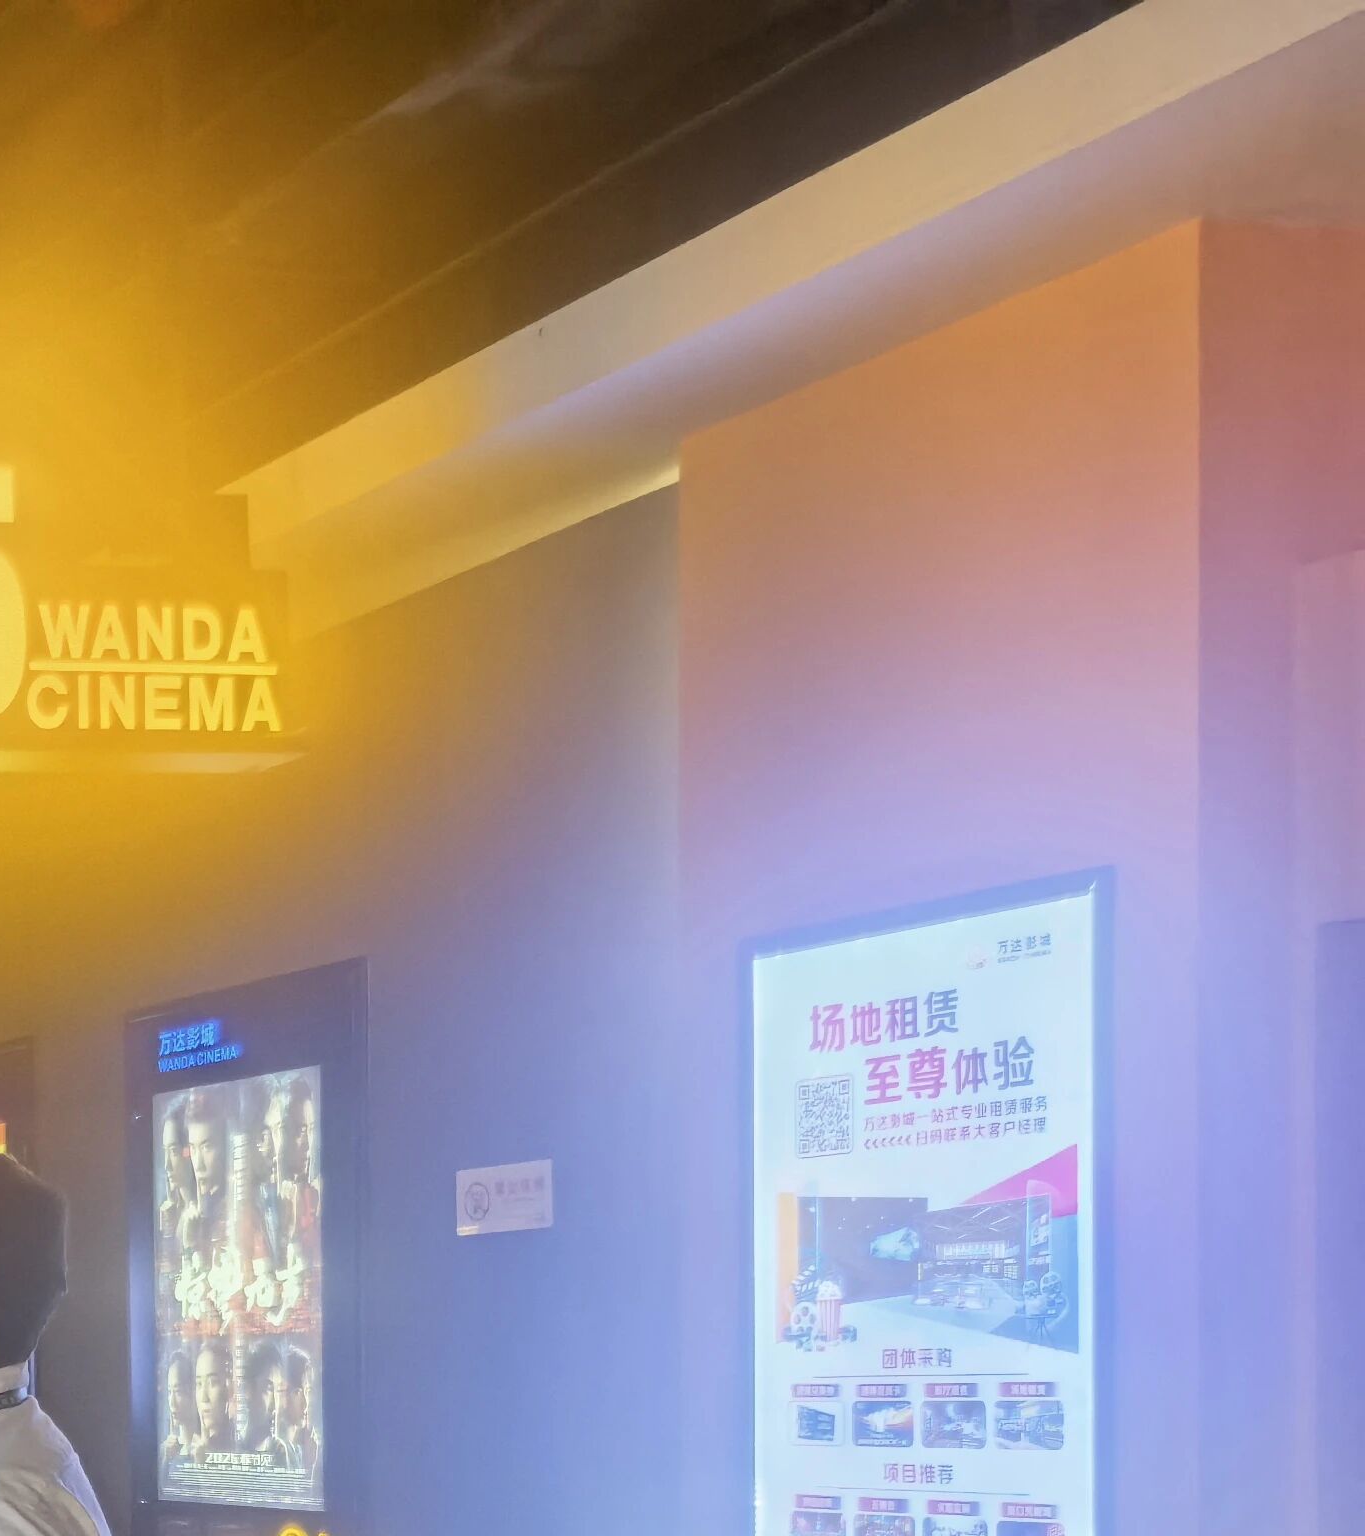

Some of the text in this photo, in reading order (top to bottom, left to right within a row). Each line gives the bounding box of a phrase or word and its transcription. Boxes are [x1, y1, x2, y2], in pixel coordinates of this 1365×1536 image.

[38, 603, 269, 663] WANDA
[26, 673, 282, 733] CINEMA
[158, 1023, 215, 1057] 万达影城
[809, 988, 959, 1053] 场地租赁
[158, 1046, 238, 1073] WANDA CINEMA
[864, 1036, 1035, 1106] 至尊体验
[882, 1348, 952, 1369] 团体采购
[883, 1463, 954, 1485] 项目推荐
